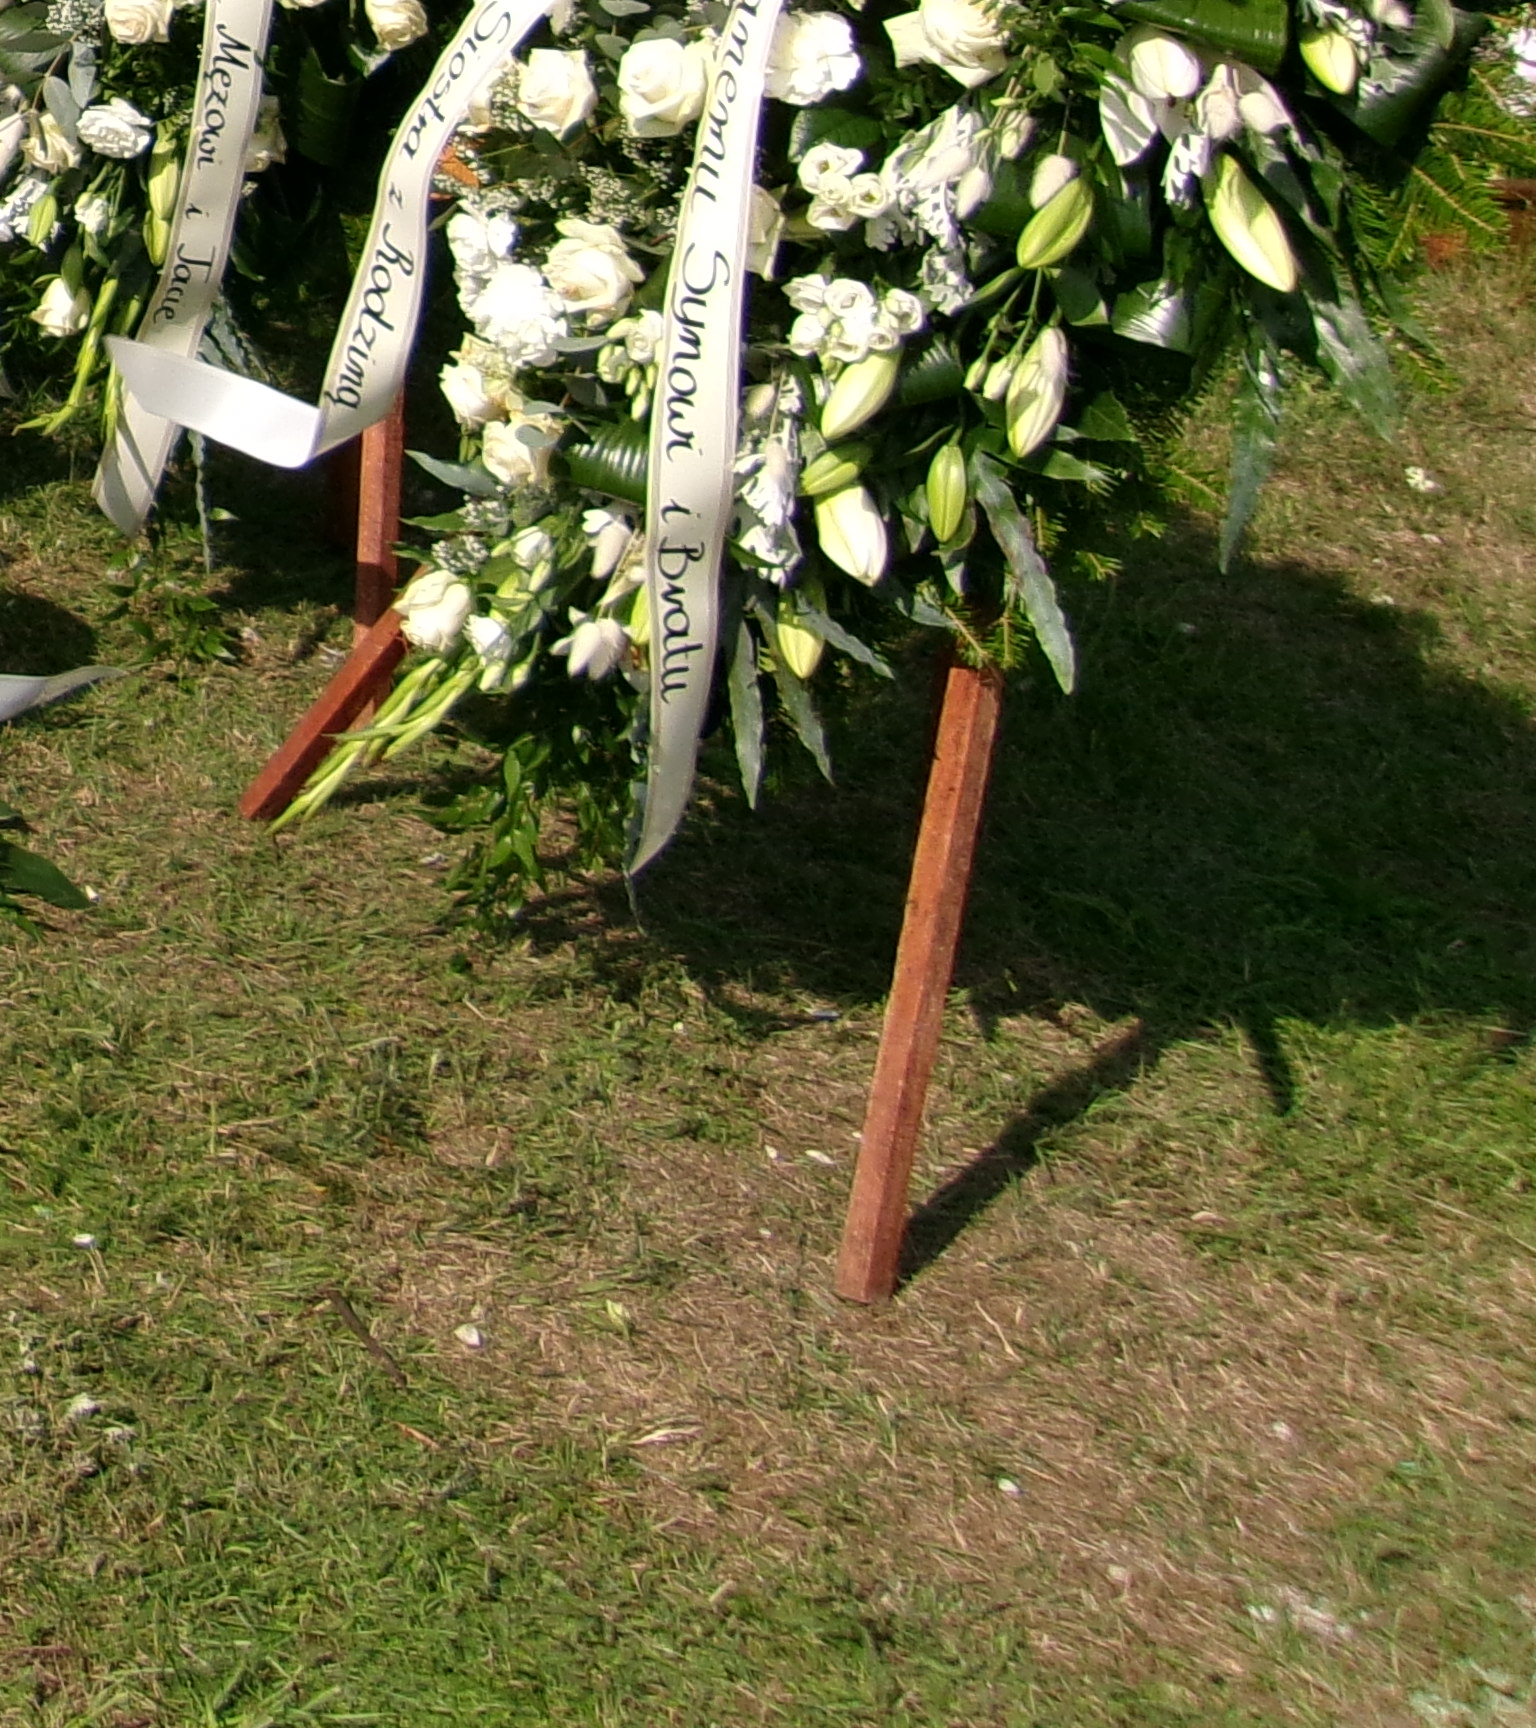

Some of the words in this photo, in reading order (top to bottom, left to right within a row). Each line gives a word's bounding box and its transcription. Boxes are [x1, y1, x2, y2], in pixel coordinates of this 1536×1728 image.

[403, 0, 512, 161] Siostra
[184, 202, 211, 219] i
[387, 182, 407, 210] z
[666, 241, 731, 463] Synowi
[659, 498, 693, 524] i
[658, 539, 705, 704] Bratu
